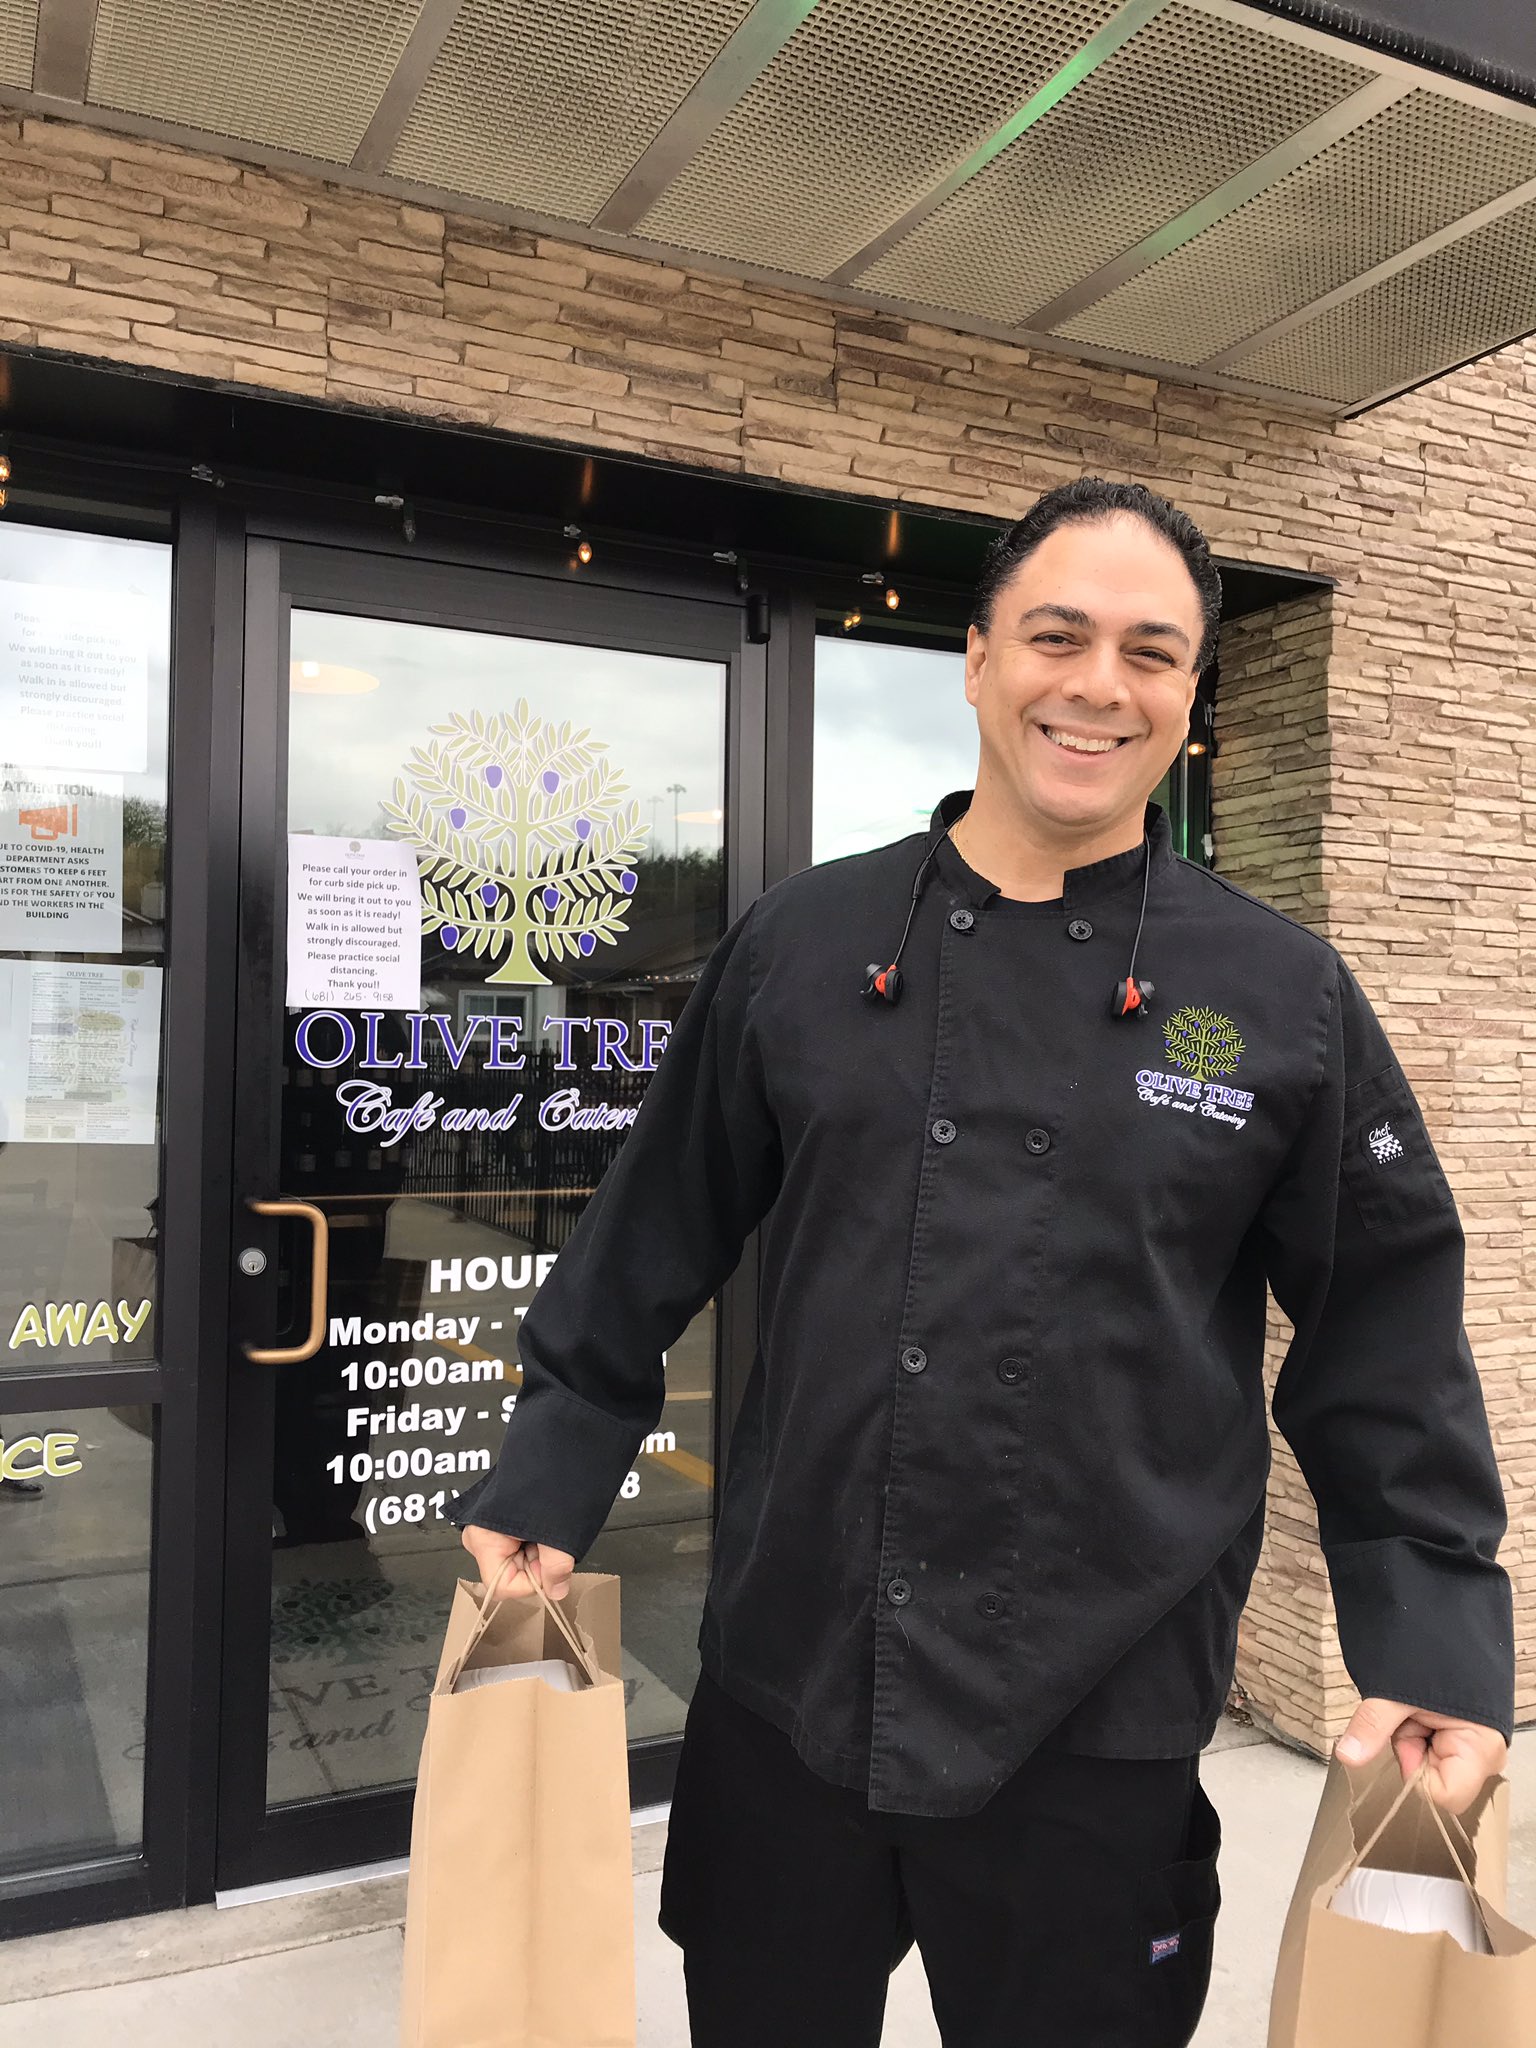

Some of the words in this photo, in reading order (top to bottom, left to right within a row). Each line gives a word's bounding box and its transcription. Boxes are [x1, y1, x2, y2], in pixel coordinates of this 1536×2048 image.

[8, 642, 26, 652] We
[29, 644, 46, 655] will
[49, 646, 75, 659] bring
[34, 660, 58, 670] soon
[18, 674, 44, 685] Walk
[47, 676, 56, 686] in
[58, 677, 66, 687] is
[69, 679, 108, 691] allowed
[20, 690, 61, 702] strongly
[25, 845, 68, 854] COVID-19,
[6, 855, 65, 864] DEPARTMENT
[302, 864, 331, 873] Please
[334, 866, 348, 874] call
[351, 868, 371, 876] your
[373, 869, 397, 877] order
[399, 869, 407, 877] in
[65, 879, 109, 887] ANOTHER.
[309, 878, 322, 886] for
[324, 878, 344, 887] curb
[346, 880, 364, 888] side
[366, 881, 384, 890] pick
[387, 883, 400, 891] up.
[31, 900, 74, 908] WORKERS
[298, 893, 312, 901] We
[315, 893, 331, 902] will
[333, 895, 356, 905] bring
[358, 896, 364, 904] it
[367, 897, 381, 905] out
[395, 899, 412, 907] you
[26, 911, 69, 919] BUILDING
[355, 909, 362, 917] it
[364, 910, 371, 918] is
[373, 911, 401, 920] ready!
[306, 922, 328, 931] Walk
[331, 923, 339, 932] in
[342, 923, 348, 932] is
[351, 924, 385, 934] allowed
[388, 926, 402, 934] but
[307, 937, 343, 946] strongly
[346, 938, 400, 948] discouraged.
[308, 952, 336, 960] Please
[338, 953, 373, 962] practice
[376, 954, 400, 963] social
[330, 967, 378, 976] distancing.
[328, 980, 355, 988] Thank
[357, 981, 380, 989] you!!
[295, 1010, 526, 1070] OLIVE
[544, 1016, 672, 1071] TRE
[1136, 1070, 1202, 1099] OLIVE
[1204, 1084, 1254, 1112] TREE
[336, 1079, 444, 1148] Café
[441, 1094, 523, 1131] and
[538, 1088, 644, 1132] Cater
[1137, 1087, 1172, 1106] Café
[1172, 1101, 1197, 1113] and
[1200, 1101, 1246, 1130] Catering
[1369, 1122, 1390, 1142] Chef
[8, 1299, 152, 1349] AWAY
[329, 1312, 481, 1347] Monday
[341, 1357, 504, 1391] 10:00am
[347, 1403, 467, 1437] Friday
[326, 1448, 491, 1484] 10:00am
[365, 1489, 460, 1534] (681
